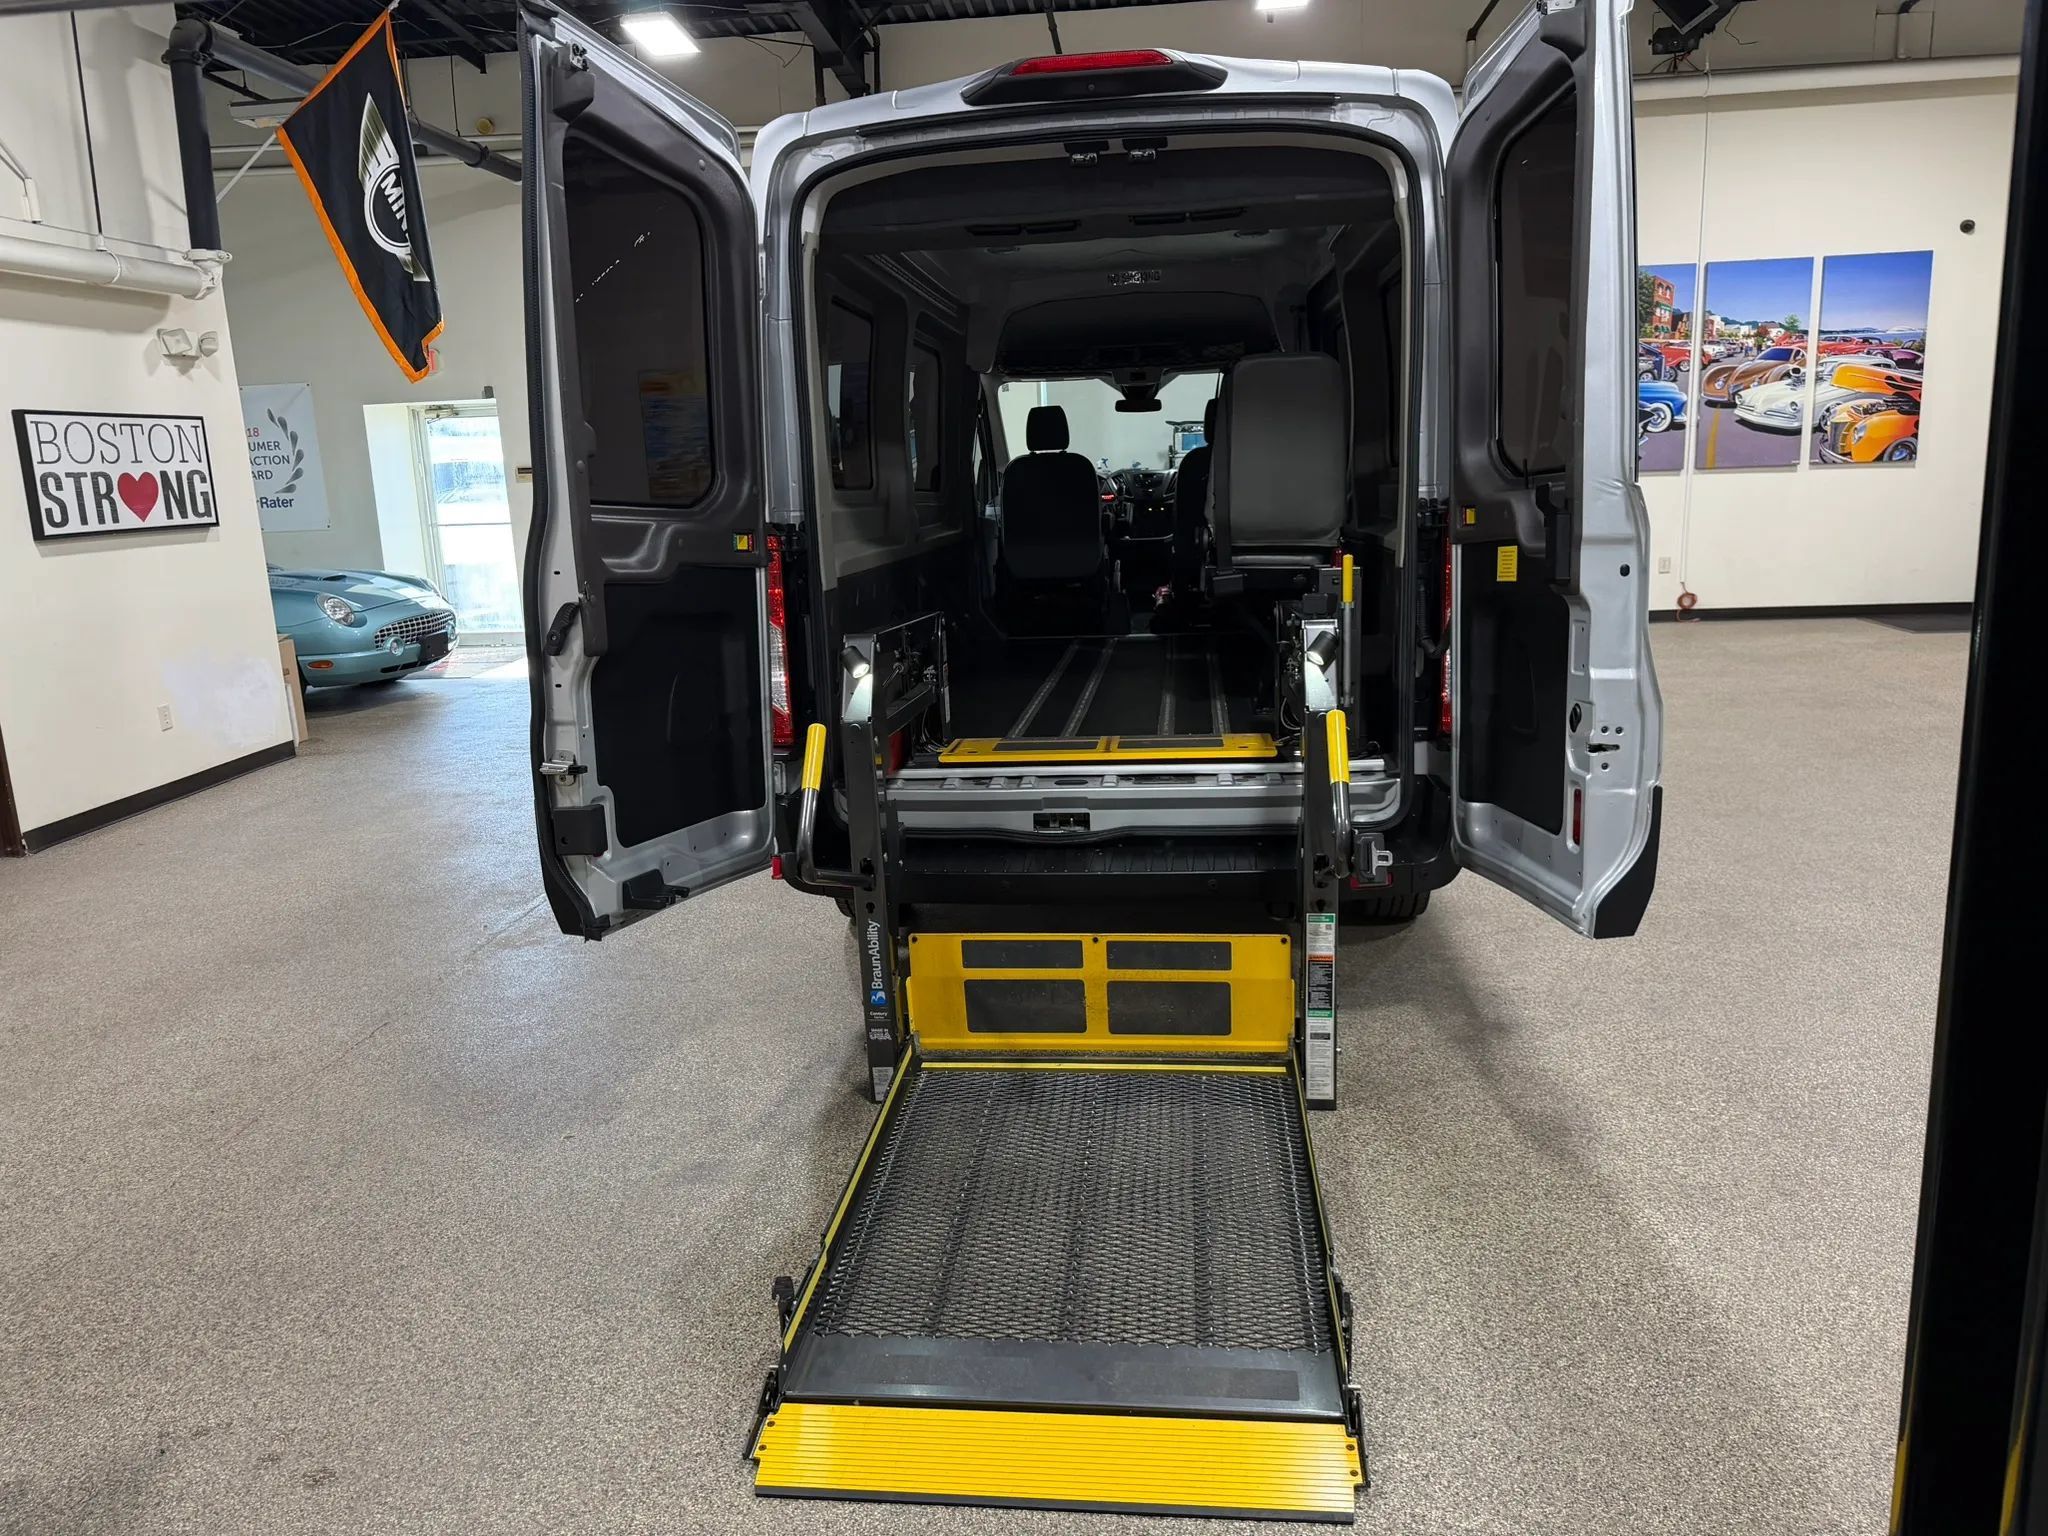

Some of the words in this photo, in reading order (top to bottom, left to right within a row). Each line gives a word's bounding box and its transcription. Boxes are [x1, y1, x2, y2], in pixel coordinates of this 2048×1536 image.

[30, 420, 203, 464] BOSTON
[39, 470, 213, 528] STRNG
[256, 496, 294, 508] Rater
[868, 919, 882, 989] BraunAbility
